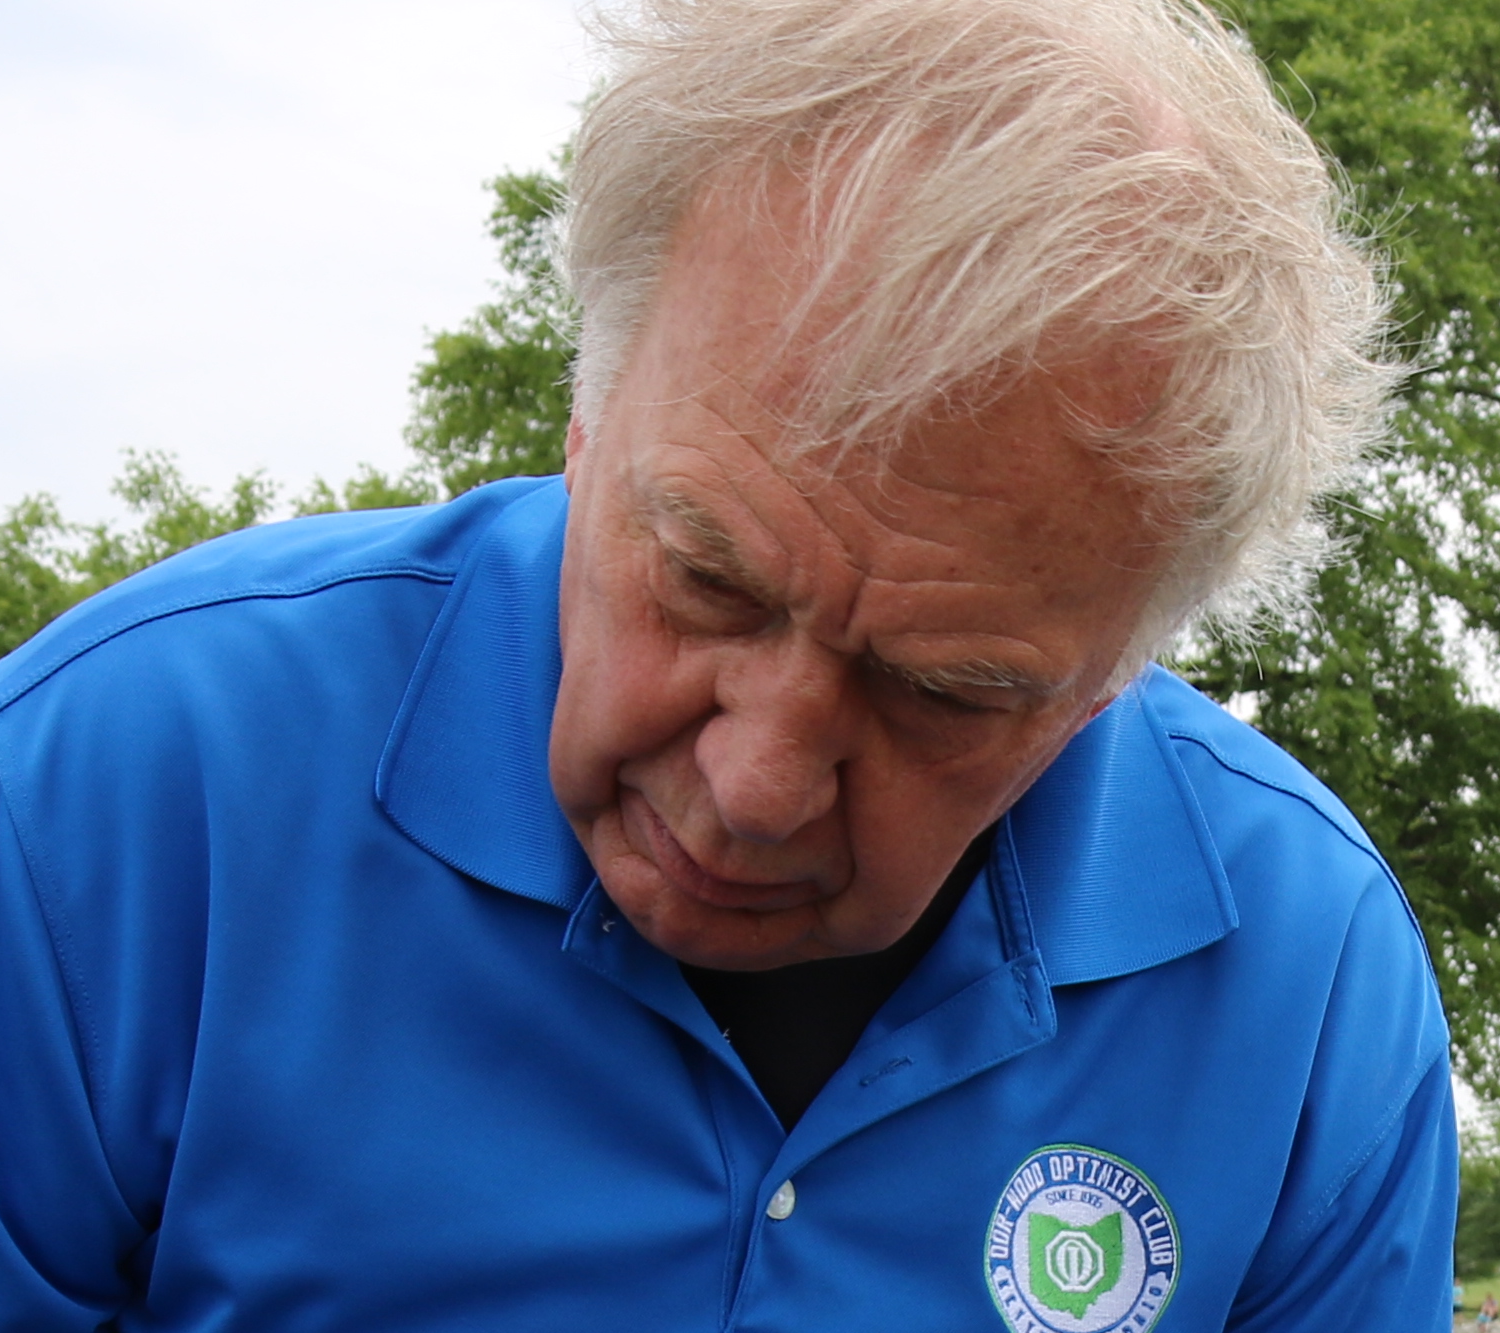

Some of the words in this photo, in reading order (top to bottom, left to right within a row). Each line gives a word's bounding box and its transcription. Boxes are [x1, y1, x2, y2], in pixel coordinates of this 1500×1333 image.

[1045, 1188, 1079, 1207] SINCE
[1049, 1155, 1148, 1209] OPTIMIST
[1139, 1206, 1174, 1266] CLUB
